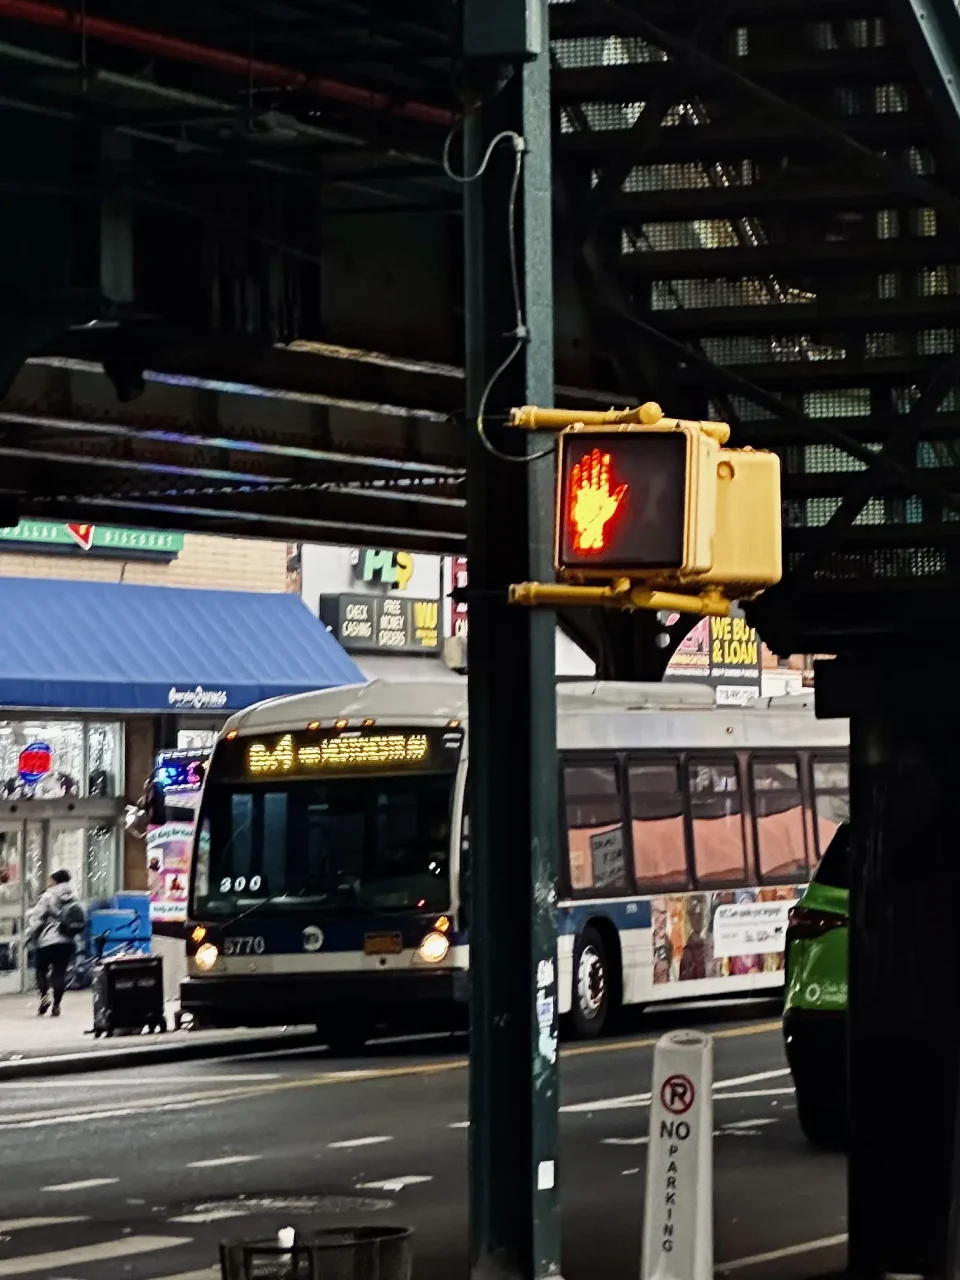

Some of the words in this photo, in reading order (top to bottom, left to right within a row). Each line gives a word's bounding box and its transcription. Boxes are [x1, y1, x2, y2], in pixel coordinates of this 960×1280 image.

[711, 616, 732, 640] WE
[724, 641, 758, 665] LOAN
[659, 1120, 691, 1141] NO
[662, 1144, 678, 1253] PARKING
